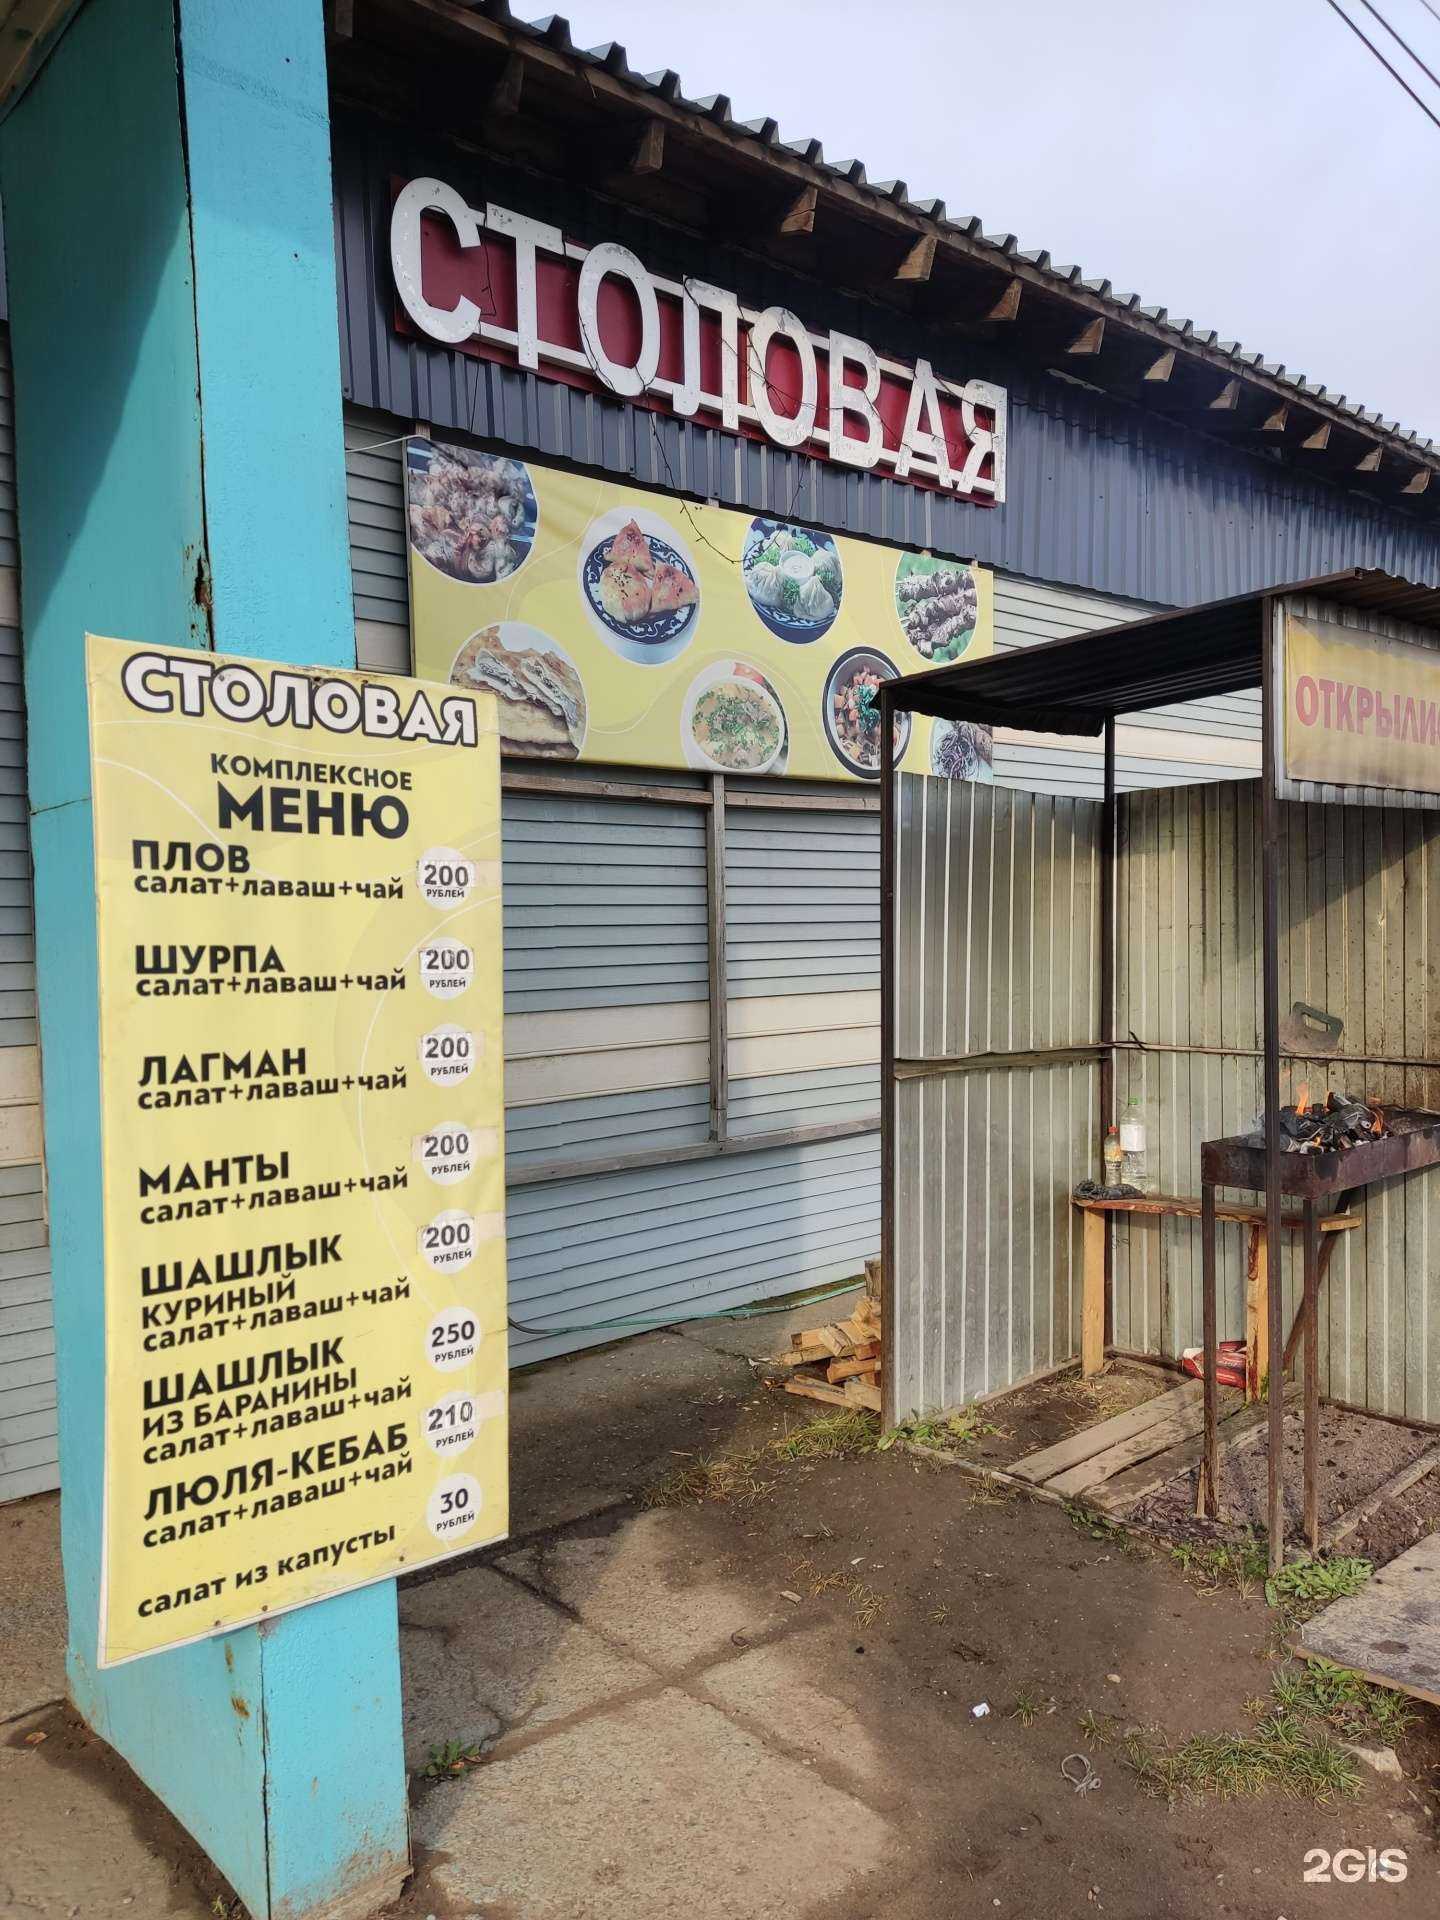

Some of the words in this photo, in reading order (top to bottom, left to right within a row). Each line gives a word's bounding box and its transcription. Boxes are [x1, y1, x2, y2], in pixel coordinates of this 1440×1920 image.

[391, 176, 1007, 503] СТОЛОВАЯ
[121, 652, 478, 747] СТОЛОВАЯ
[1295, 675, 1440, 746] ОТКРЫЛИ
[211, 753, 412, 791] КОМПЛЕКСНОЕ
[217, 781, 409, 839] МЕНЮ
[132, 840, 250, 873] ПЛОВ
[134, 874, 404, 900] салат+лаваш+чай
[424, 864, 468, 887] 200
[427, 889, 464, 898] РУБЛЕЙ
[135, 945, 285, 975] ШУРПА
[426, 950, 469, 970] 200
[136, 970, 406, 997] салат+лаваш+чай
[429, 977, 466, 988] РУБЛЕЙ
[425, 1036, 469, 1060] 200
[138, 1047, 306, 1087] ЛАГМАН
[430, 1064, 469, 1076] РУБЛЕЙ
[138, 1066, 407, 1110] салат+лаваш+чай
[424, 1133, 469, 1158] 200
[139, 1151, 289, 1197] МАНТЫ
[431, 1161, 470, 1175] РУБЛЕЙ
[140, 1166, 408, 1224] салат+лаваш+чай
[425, 1223, 470, 1249] 200
[142, 1234, 343, 1297] ШАШЛЫК
[433, 1248, 472, 1264] РУБЛЕЙ
[143, 1273, 296, 1329] КУРИНЫЙ
[143, 1277, 410, 1352] салат+лаваш+чай
[431, 1320, 475, 1348] 250
[435, 1345, 474, 1363] РУБЛЕЙ
[143, 1336, 344, 1410] ШАШЛЫК
[143, 1410, 184, 1440] ИЗ
[194, 1368, 357, 1428] БАРАНИНЫ
[143, 1375, 411, 1464] салат+лаваш+чай
[427, 1401, 473, 1433] 210
[436, 1429, 474, 1448] РУБЛЕЙ
[143, 1422, 408, 1521] ЛЮЛЯ-КЕБАБ
[143, 1450, 413, 1548] салат+лаваш+чай
[440, 1488, 469, 1514] 30
[436, 1511, 475, 1531] РУБЛЕЙ
[138, 1576, 226, 1617] салат
[235, 1563, 268, 1589] из
[278, 1525, 395, 1576] капусты
